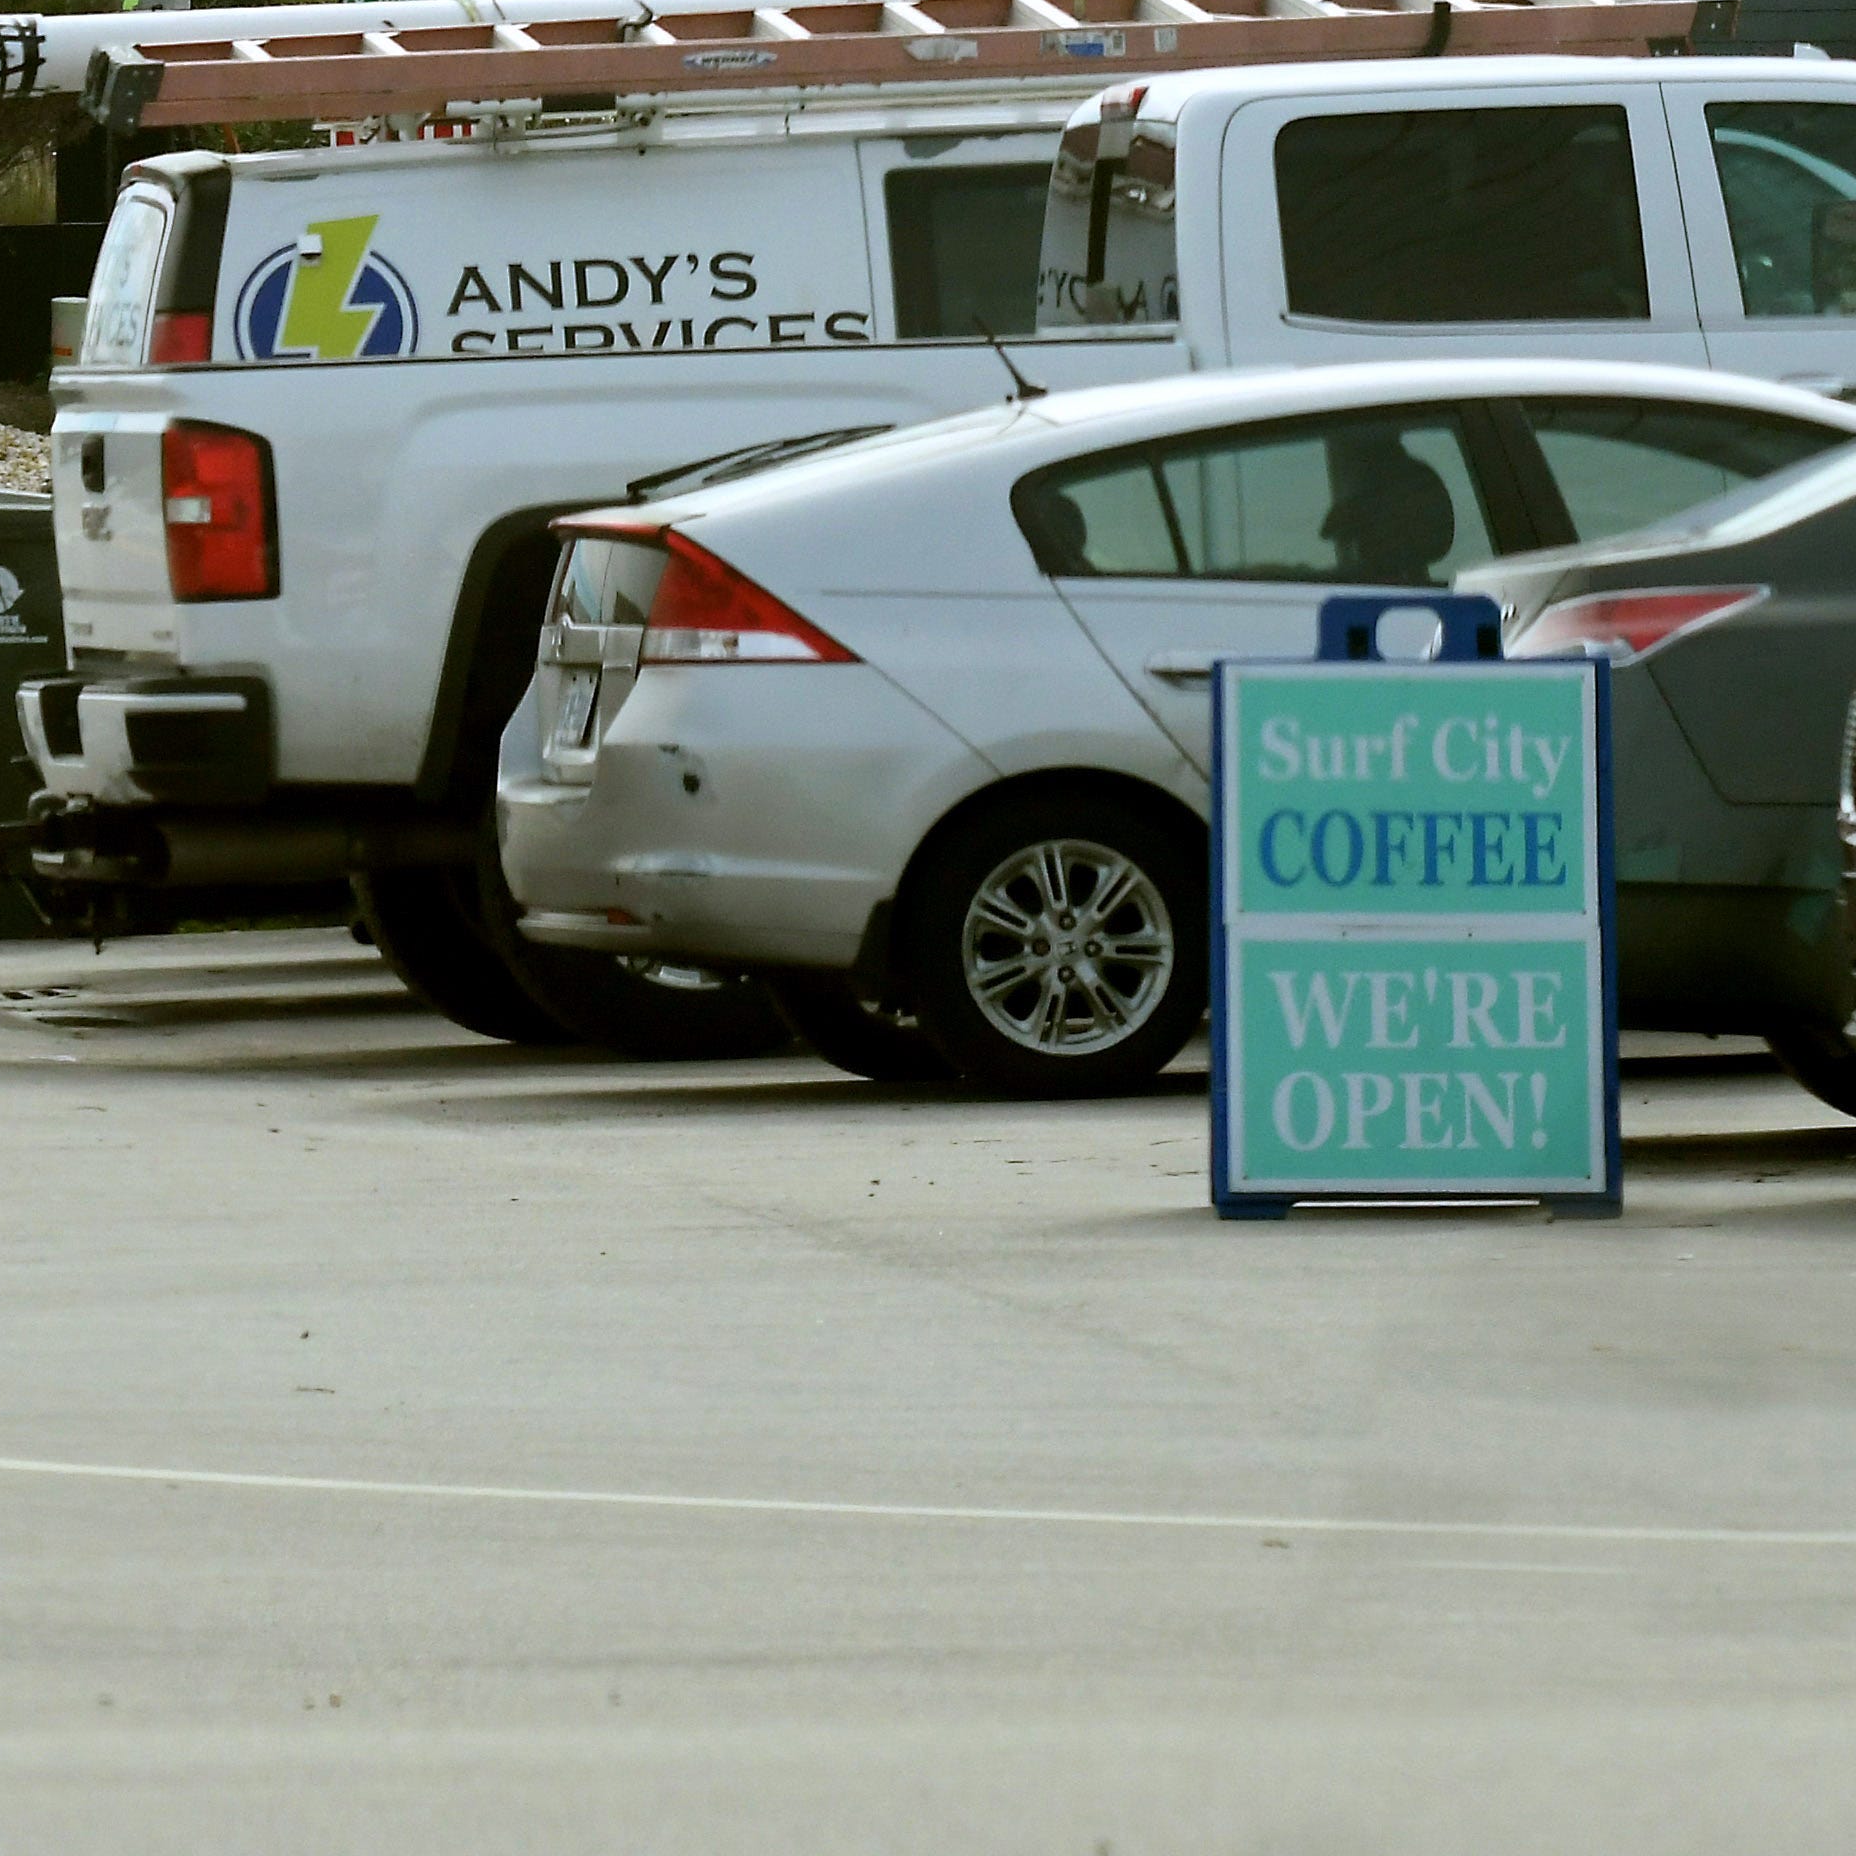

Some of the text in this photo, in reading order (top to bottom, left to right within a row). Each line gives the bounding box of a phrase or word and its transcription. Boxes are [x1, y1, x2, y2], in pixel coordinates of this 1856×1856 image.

[446, 251, 758, 316] ANDY'S
[1260, 716, 1571, 798] Surf City
[1259, 808, 1567, 889] COFFEE
[1266, 966, 1567, 1050] WE'RE
[1271, 1070, 1549, 1152] OPEN!
